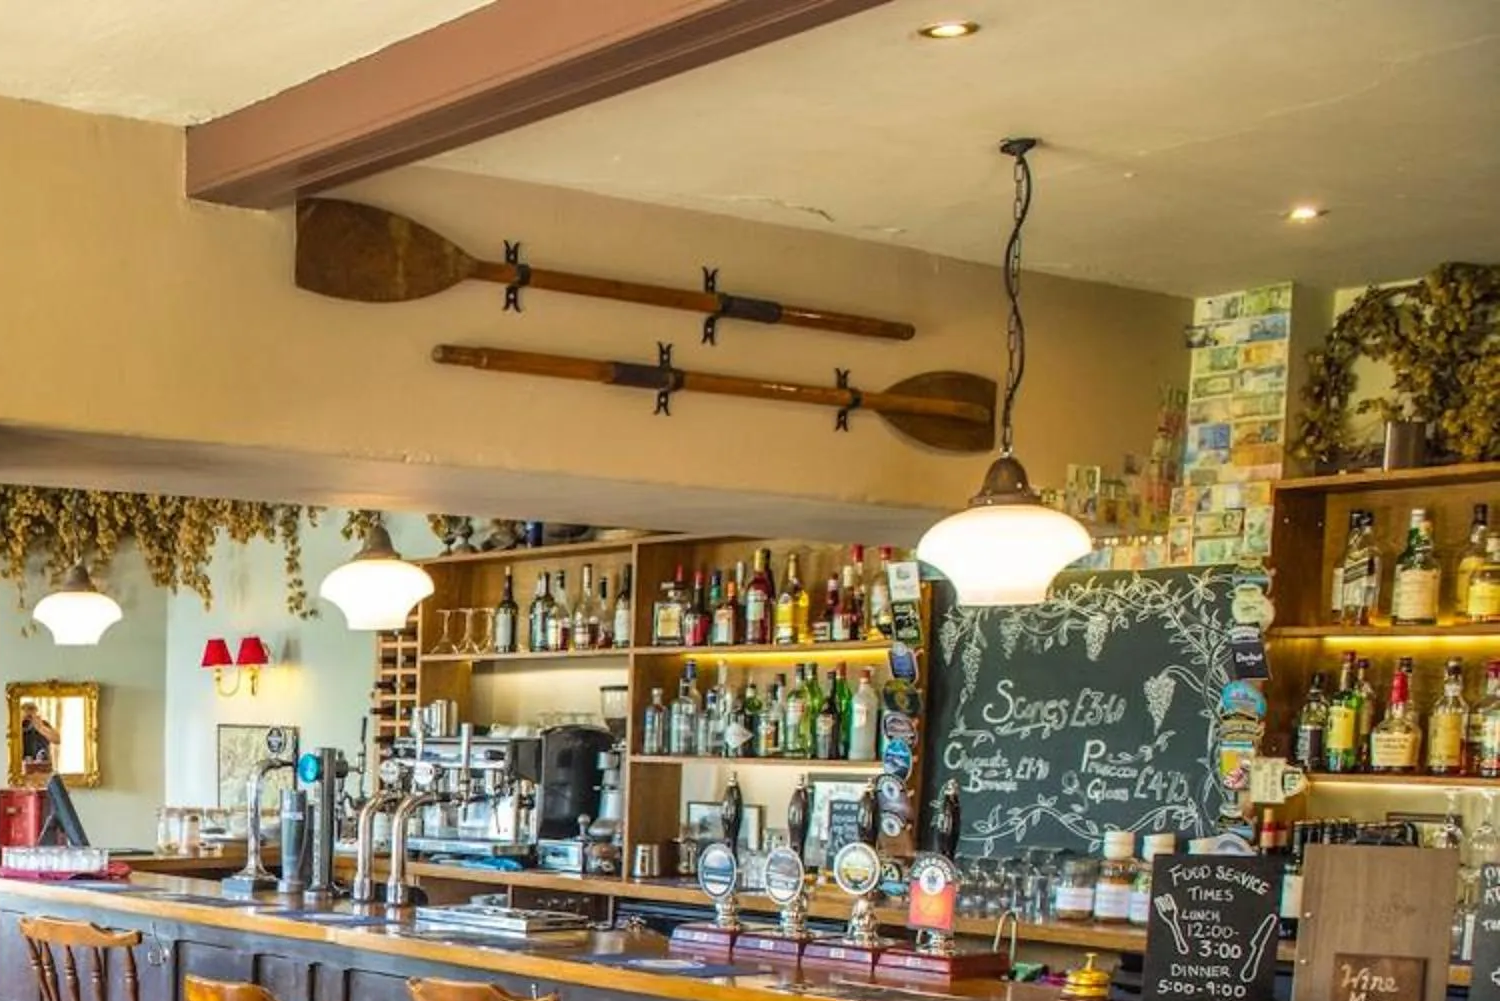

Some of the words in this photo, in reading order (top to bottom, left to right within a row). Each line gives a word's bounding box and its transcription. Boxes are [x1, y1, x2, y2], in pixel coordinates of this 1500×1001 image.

[1168, 863, 1211, 887] FOOD
[1215, 865, 1270, 896] SERVICE
[1187, 885, 1234, 902] TIMES
[1181, 908, 1221, 922] LUNCH
[1198, 940, 1242, 959] 3:00
[1170, 963, 1231, 978] DINNER
[1340, 963, 1399, 993] Wine
